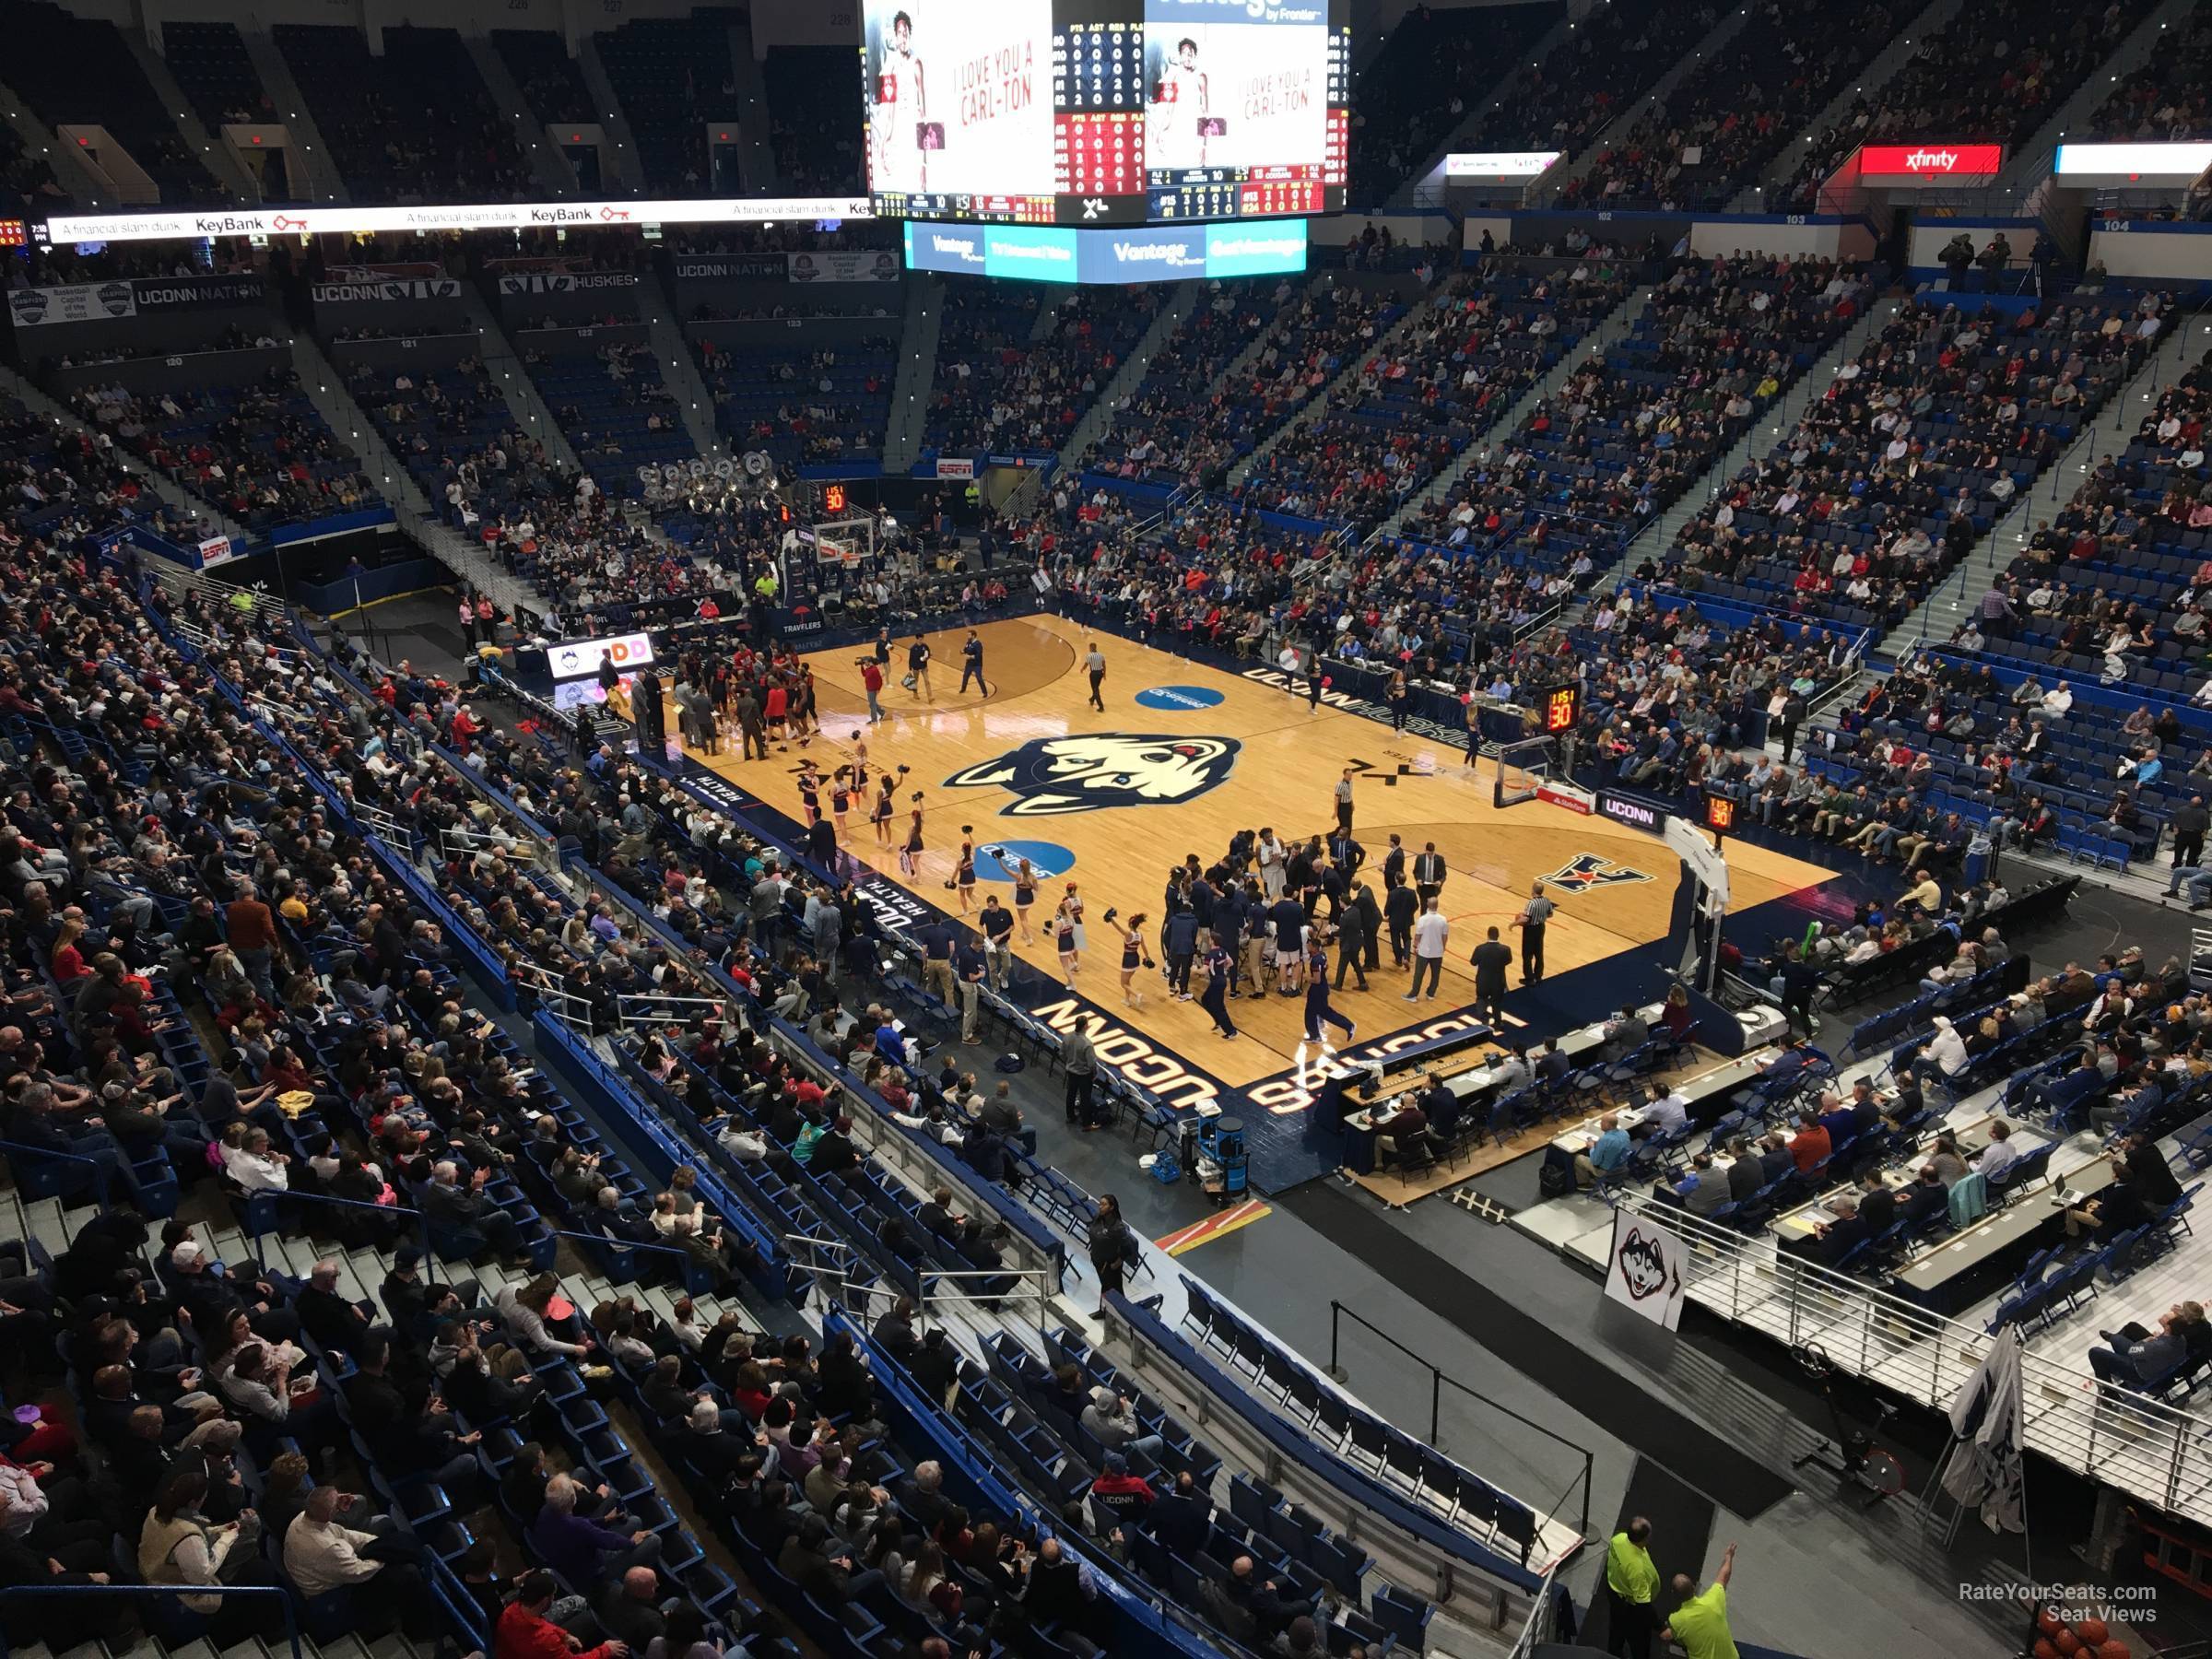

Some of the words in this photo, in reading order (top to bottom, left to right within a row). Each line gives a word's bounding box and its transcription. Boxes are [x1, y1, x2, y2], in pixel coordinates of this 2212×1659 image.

[1266, 7, 1278, 22] by
[1280, 7, 1316, 20] Frontier
[1088, 23, 1104, 31] AST
[1073, 33, 1081, 45] 0
[1091, 33, 1101, 44] 0
[1112, 33, 1122, 44] 0
[1133, 33, 1141, 44] 0
[1073, 49, 1081, 60] 0
[1092, 49, 1101, 60] 0
[1112, 48, 1122, 59] 0
[1133, 48, 1141, 59] 0
[961, 55, 989, 91] LOVE
[995, 43, 1020, 78] YOU
[1025, 39, 1032, 67] A
[1092, 64, 1101, 75] 0
[1113, 63, 1122, 75] 0
[1135, 63, 1140, 74] 1
[1076, 78, 1081, 89] 1
[1093, 77, 1101, 89] 2
[1113, 77, 1122, 89] 2
[1133, 77, 1142, 88] 0
[1246, 74, 1272, 97] LOVE
[1278, 68, 1300, 88] YOU
[1304, 67, 1311, 84] A
[961, 73, 1031, 126] CARL-TON
[1075, 93, 1082, 105] 2
[1093, 93, 1102, 104] 0
[1113, 92, 1123, 104] 0
[1135, 92, 1140, 103] 1
[1244, 88, 1309, 121] CARL-TON
[1075, 124, 1083, 135] 0
[1096, 124, 1101, 135] 1
[1114, 123, 1123, 135] 0
[1134, 123, 1142, 134] 0
[1076, 138, 1083, 149] 0
[1094, 138, 1103, 149] 0
[1114, 137, 1124, 148] 0
[1134, 137, 1142, 148] 0
[1096, 152, 1101, 163] 1
[1114, 152, 1124, 163] 0
[1134, 151, 1142, 162] 0
[1906, 150, 1958, 171] xfinity
[1076, 167, 1084, 178] 0
[1094, 167, 1104, 178] 0
[1114, 166, 1124, 178] 0
[1135, 166, 1141, 177] 1
[1212, 170, 1223, 181] 10
[1076, 182, 1084, 193] 0
[1095, 182, 1104, 193] 0
[1117, 181, 1123, 192] 1
[1135, 181, 1141, 192] 1
[1083, 198, 1109, 218] XL
[418, 212, 461, 222] financial
[465, 212, 488, 221] slam
[491, 211, 517, 221] dunk
[531, 208, 592, 223] KeyBank
[1598, 212, 1611, 220] 102
[1786, 215, 1806, 225] 103
[64, 225, 71, 235] A
[74, 223, 118, 235] financial
[121, 222, 147, 233] slam
[151, 221, 181, 232] dunk
[195, 217, 265, 232] KeyBank
[2104, 220, 2129, 231] 104
[1113, 242, 1186, 265] Vantage
[677, 264, 727, 276] UCONN
[730, 264, 783, 276] NATIN
[575, 274, 634, 288] HUSKIES
[138, 287, 198, 304] UCONN
[200, 285, 261, 300] NATIN
[312, 285, 380, 302] UCONN
[577, 328, 593, 337] 122
[401, 338, 417, 347] 121
[166, 357, 182, 367] 120
[938, 464, 971, 474] ESPN
[827, 495, 842, 510] 30
[203, 540, 229, 560] ESPN
[783, 621, 821, 633] TRAVELERS
[1552, 703, 1571, 728] 30
[697, 776, 744, 802] HEALTH
[1606, 799, 1653, 825] UCONN
[1712, 810, 1727, 826] 30
[866, 881, 928, 916] HEALTH
[1030, 998, 1220, 1110] UCONN
[1102, 1496, 1134, 1504] UCONN
